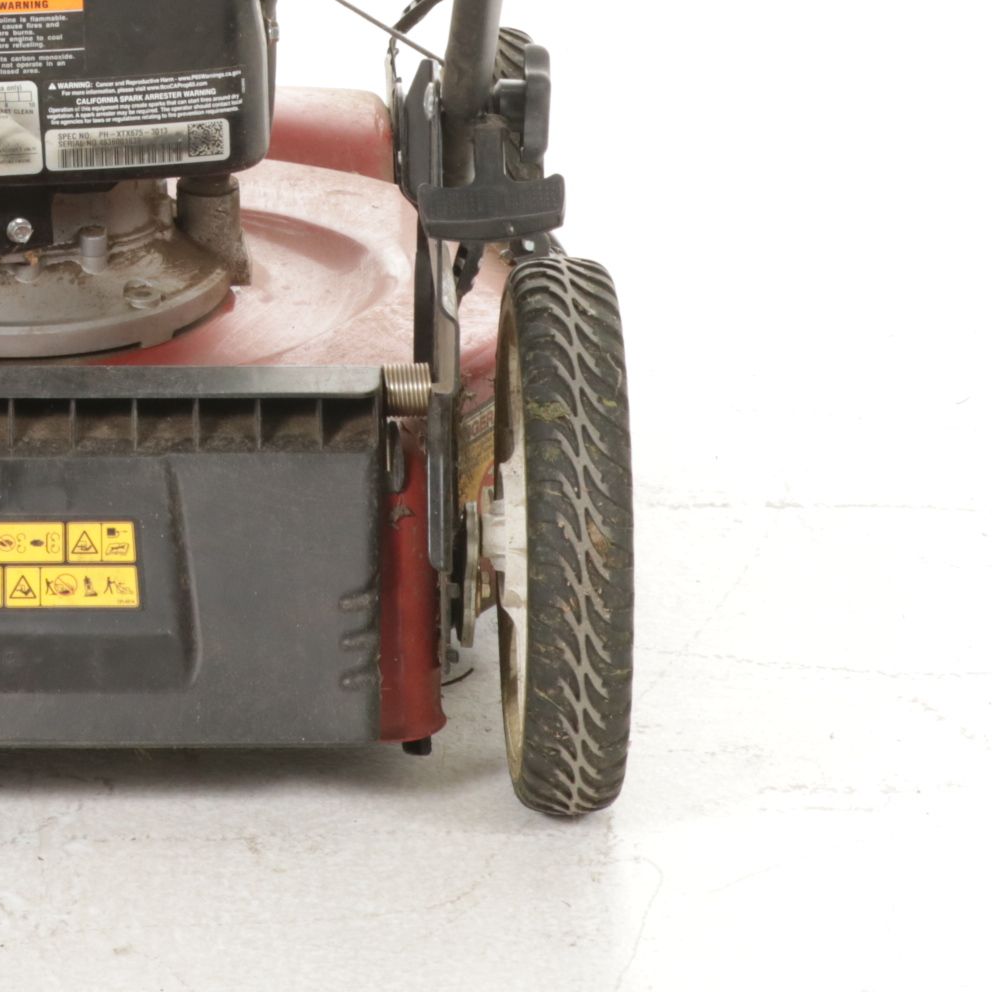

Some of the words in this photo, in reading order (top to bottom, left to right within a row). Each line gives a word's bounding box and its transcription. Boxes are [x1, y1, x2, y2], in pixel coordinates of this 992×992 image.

[6, 84, 23, 92] only)
[57, 81, 93, 89] WARNING:
[76, 96, 119, 105] CALIFORNIA
[120, 94, 143, 103] SPARK
[144, 91, 182, 100] ARRESTER
[183, 88, 216, 97] WARNING
[58, 140, 79, 148] SERIAL
